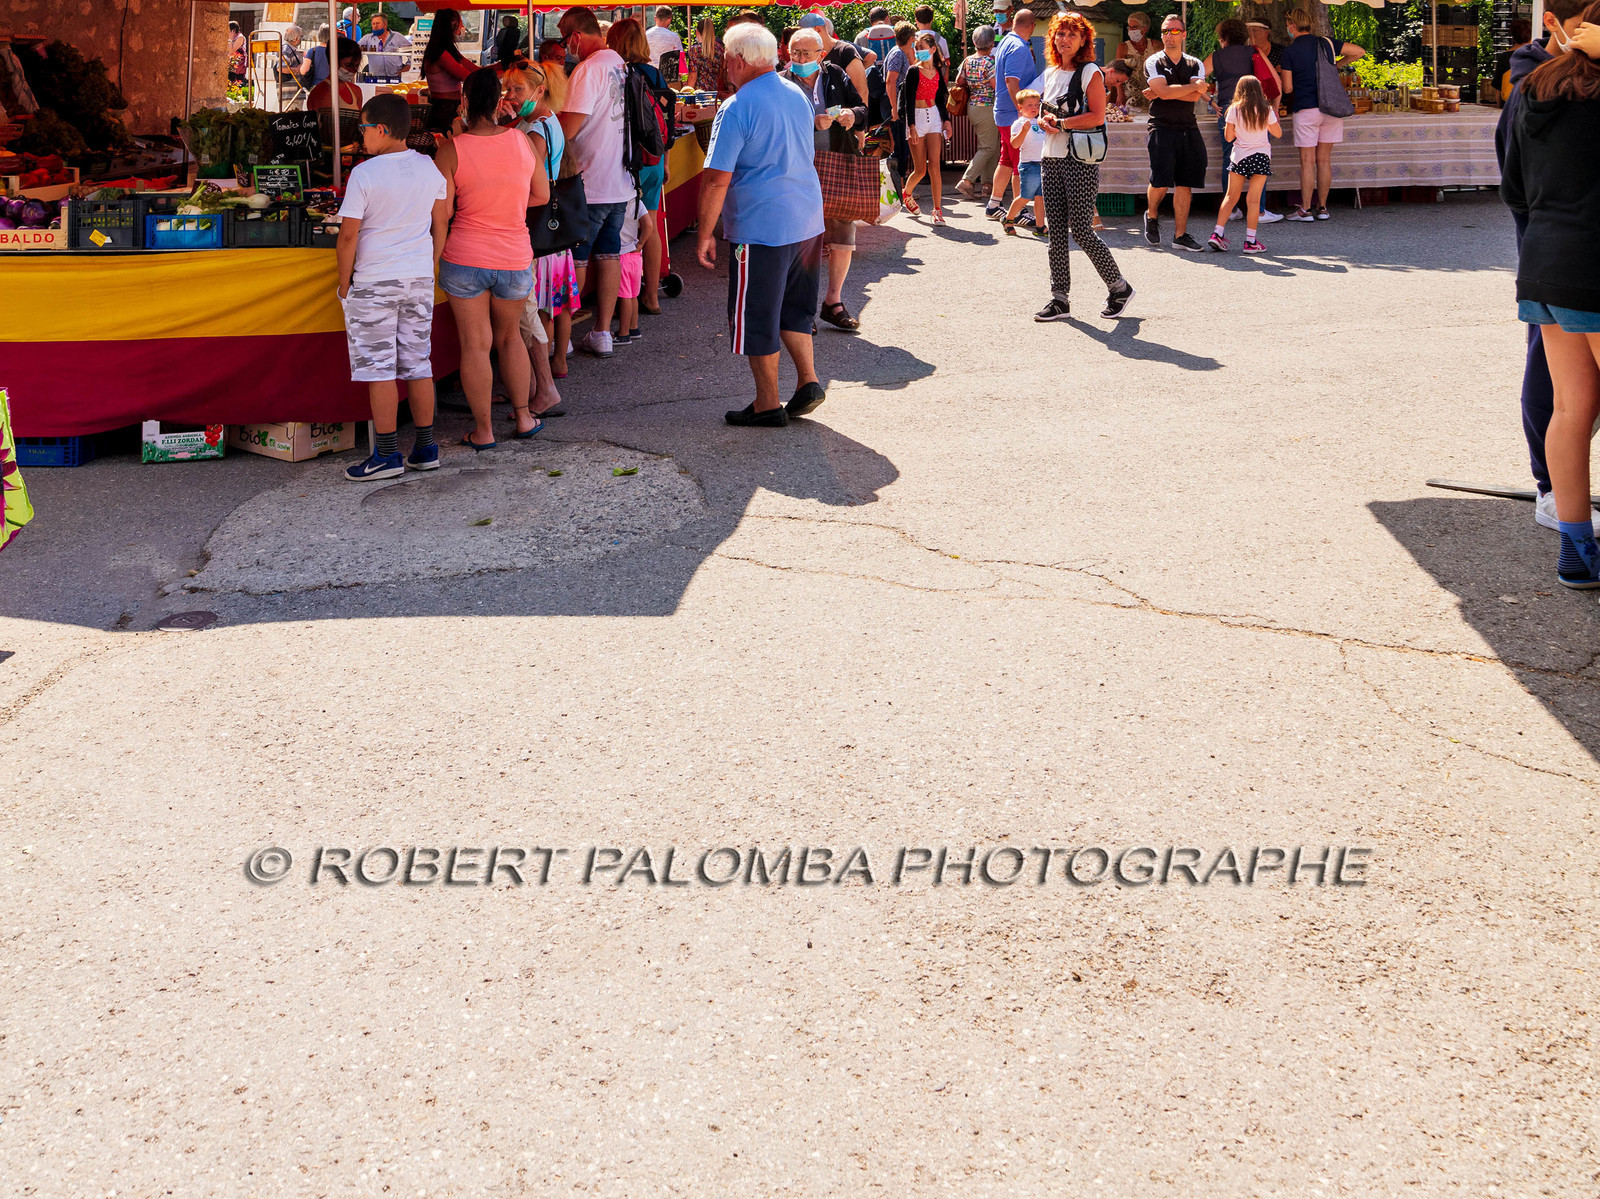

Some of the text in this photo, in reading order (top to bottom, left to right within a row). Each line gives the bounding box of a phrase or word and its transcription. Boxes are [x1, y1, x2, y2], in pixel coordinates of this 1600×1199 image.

[0, 233, 55, 244] BALDO
[239, 425, 261, 446] Bio
[309, 423, 336, 439] Bio
[177, 436, 205, 444] ZORDAN
